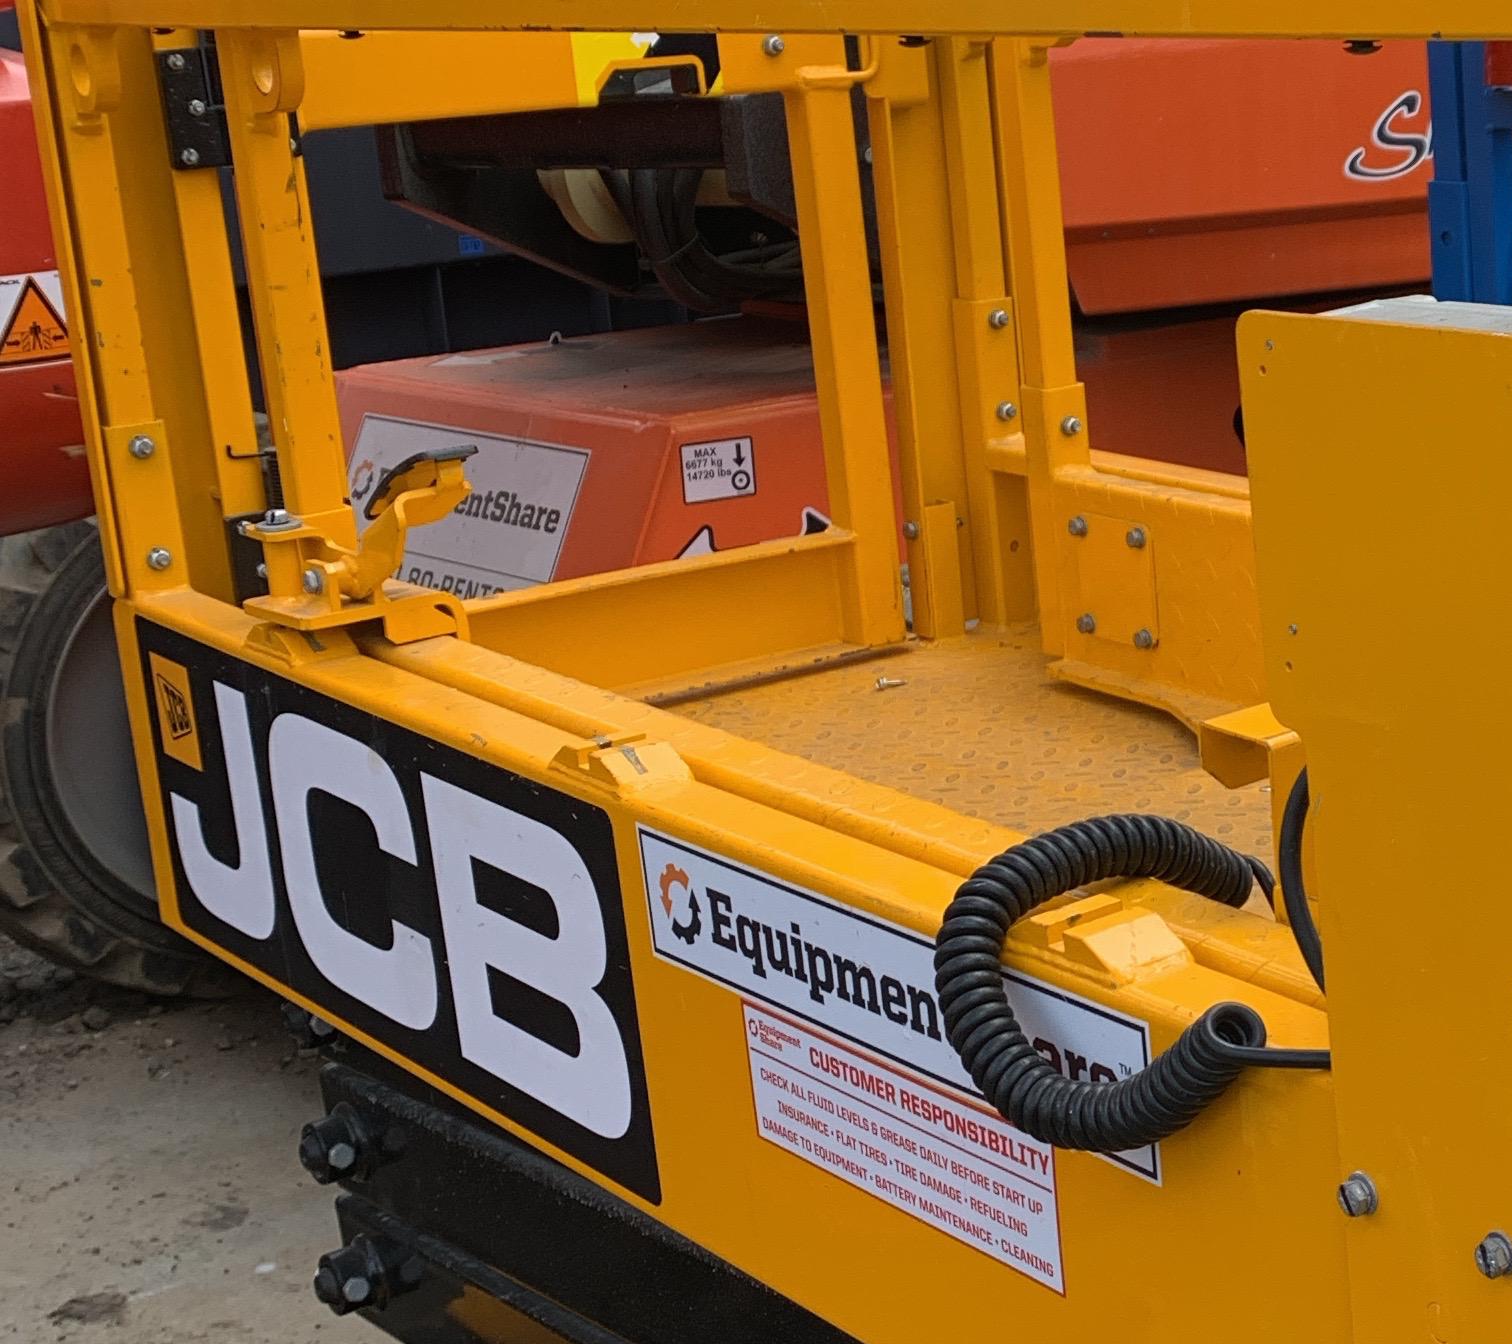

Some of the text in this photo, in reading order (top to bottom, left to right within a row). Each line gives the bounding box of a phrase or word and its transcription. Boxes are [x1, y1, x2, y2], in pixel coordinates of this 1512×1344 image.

[685, 457, 723, 471] 6677 kg
[687, 468, 732, 482] 14720 lbs
[694, 447, 717, 458] MAX
[170, 678, 633, 1140] JCB
[758, 1019, 801, 1049] Equipment
[759, 1034, 783, 1052] Share
[760, 1067, 1043, 1216] CHECK ALL FLUID LEVELS & GREASE DAILY BEFORE START UP
[809, 1046, 1049, 1176] CUSTOMER RESPONSIBILITY
[762, 1116, 1054, 1278] DAMAGE TO EQUIPMENT BATTERY MAINTENANCE CLEANING
[777, 1099, 1028, 1238] INSURANCE FLAT TIRES TIRE DAMAGE REFUELING
